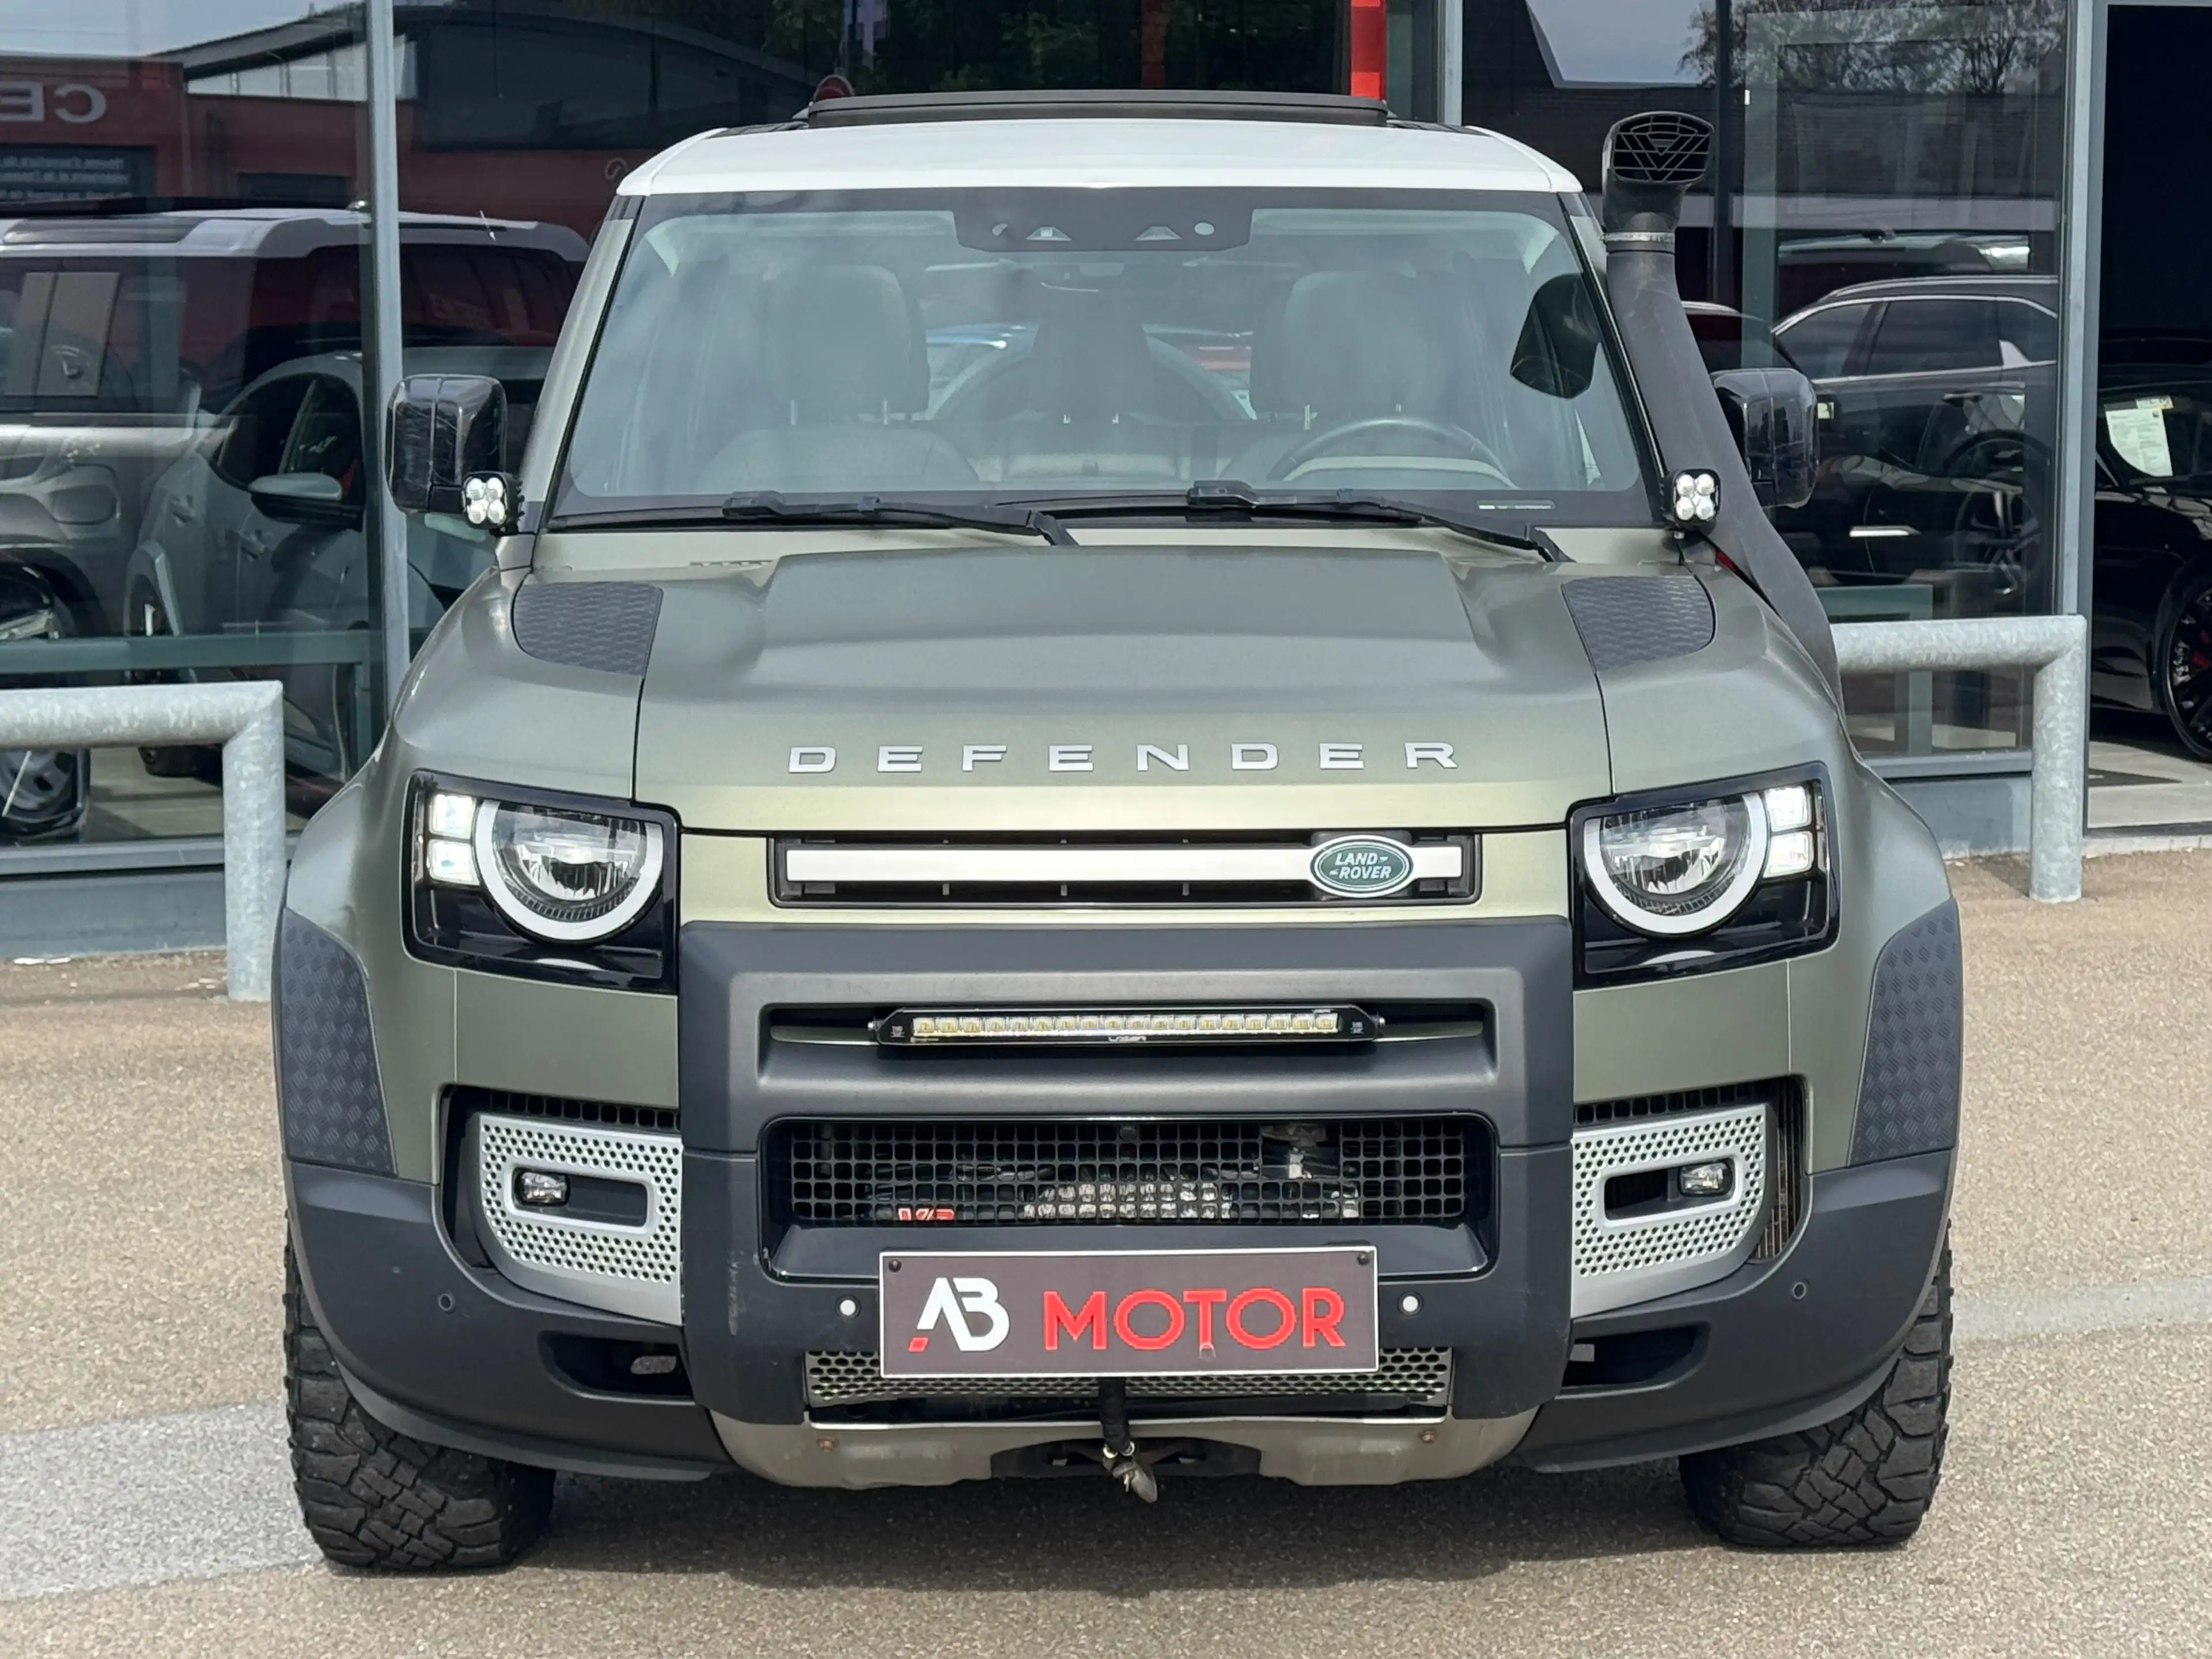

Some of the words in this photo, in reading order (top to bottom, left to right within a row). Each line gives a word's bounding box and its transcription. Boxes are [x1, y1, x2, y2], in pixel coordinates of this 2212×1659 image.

[788, 741, 1459, 774] DEFENDER
[906, 1277, 1011, 1353] AB
[1043, 1286, 1347, 1351] MOTOR
